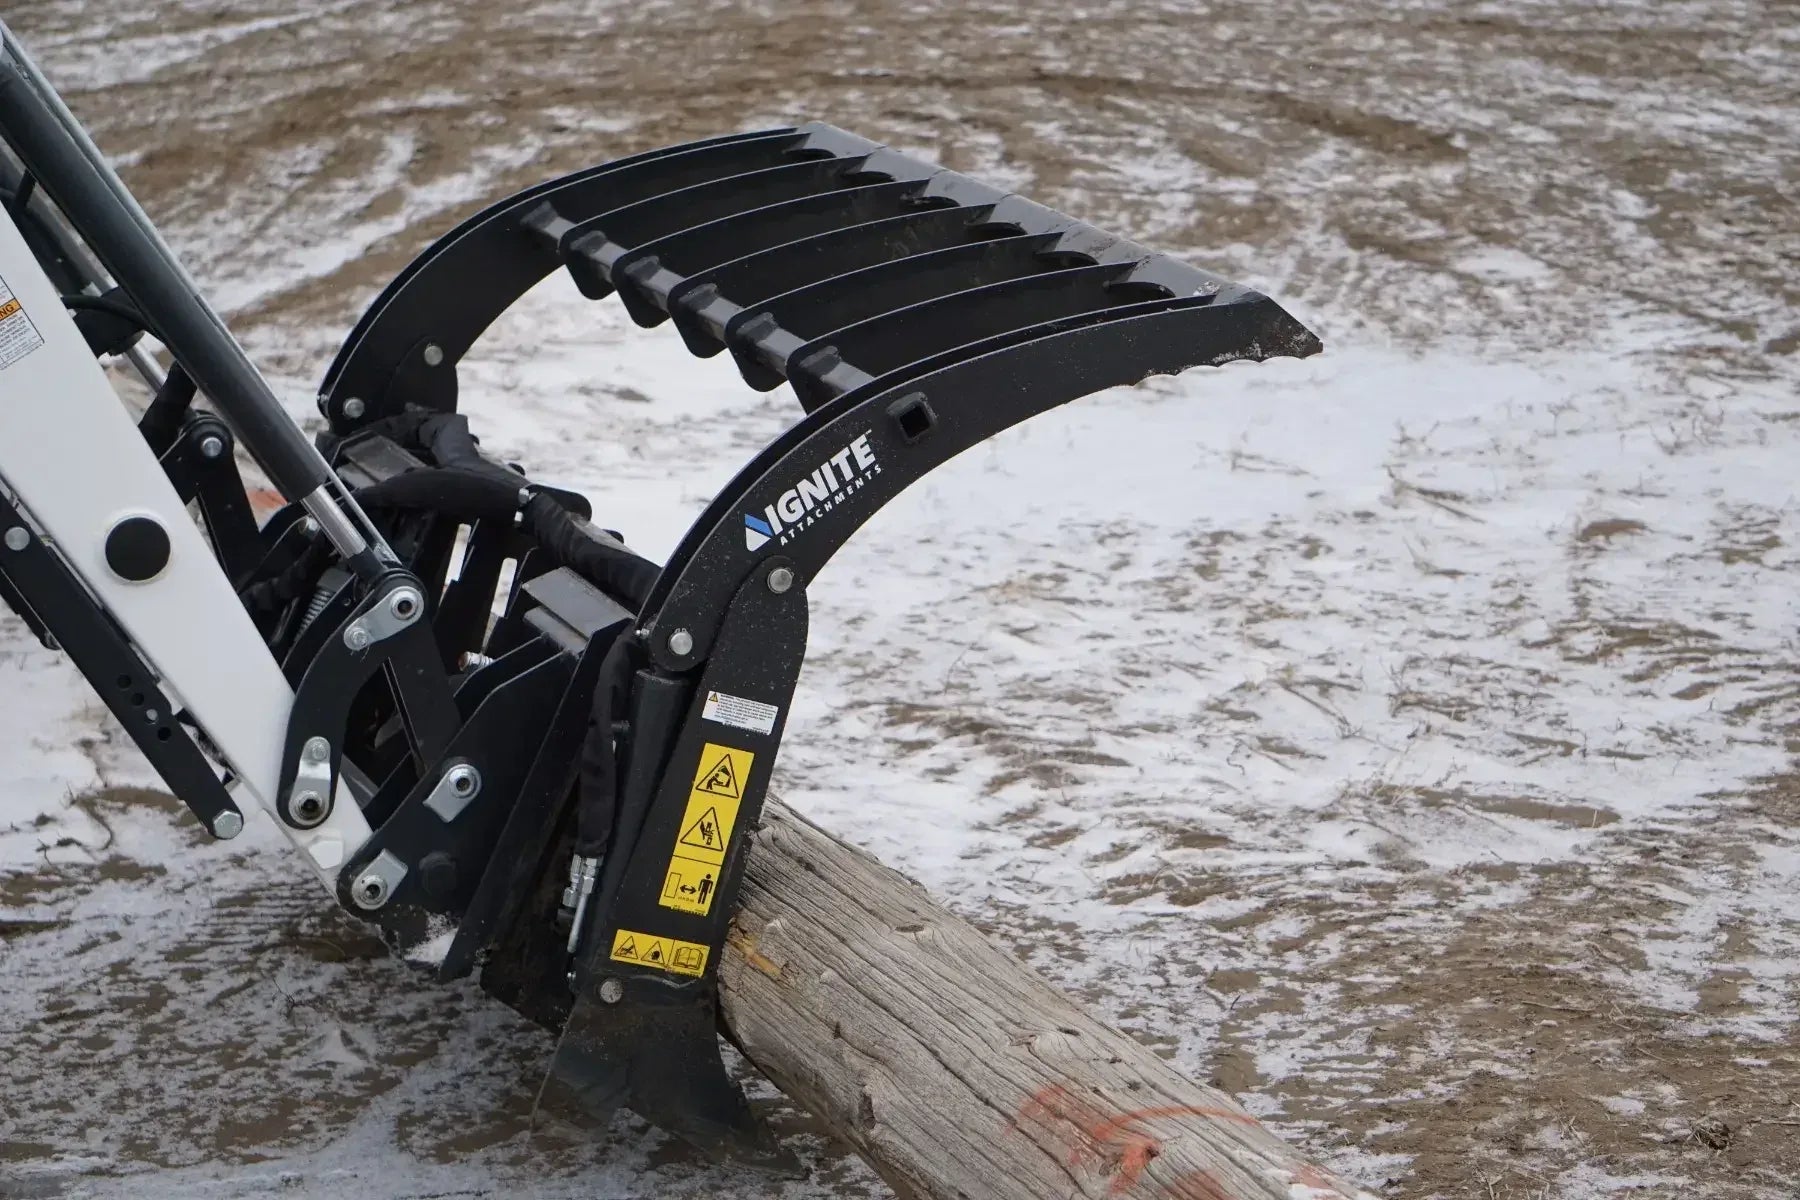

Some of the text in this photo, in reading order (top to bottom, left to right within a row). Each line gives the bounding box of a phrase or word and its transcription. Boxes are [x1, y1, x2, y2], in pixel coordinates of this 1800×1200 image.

[0, 304, 14, 319] NG
[764, 434, 876, 535] IGNITE
[780, 464, 882, 546] ATTACHMENTS
